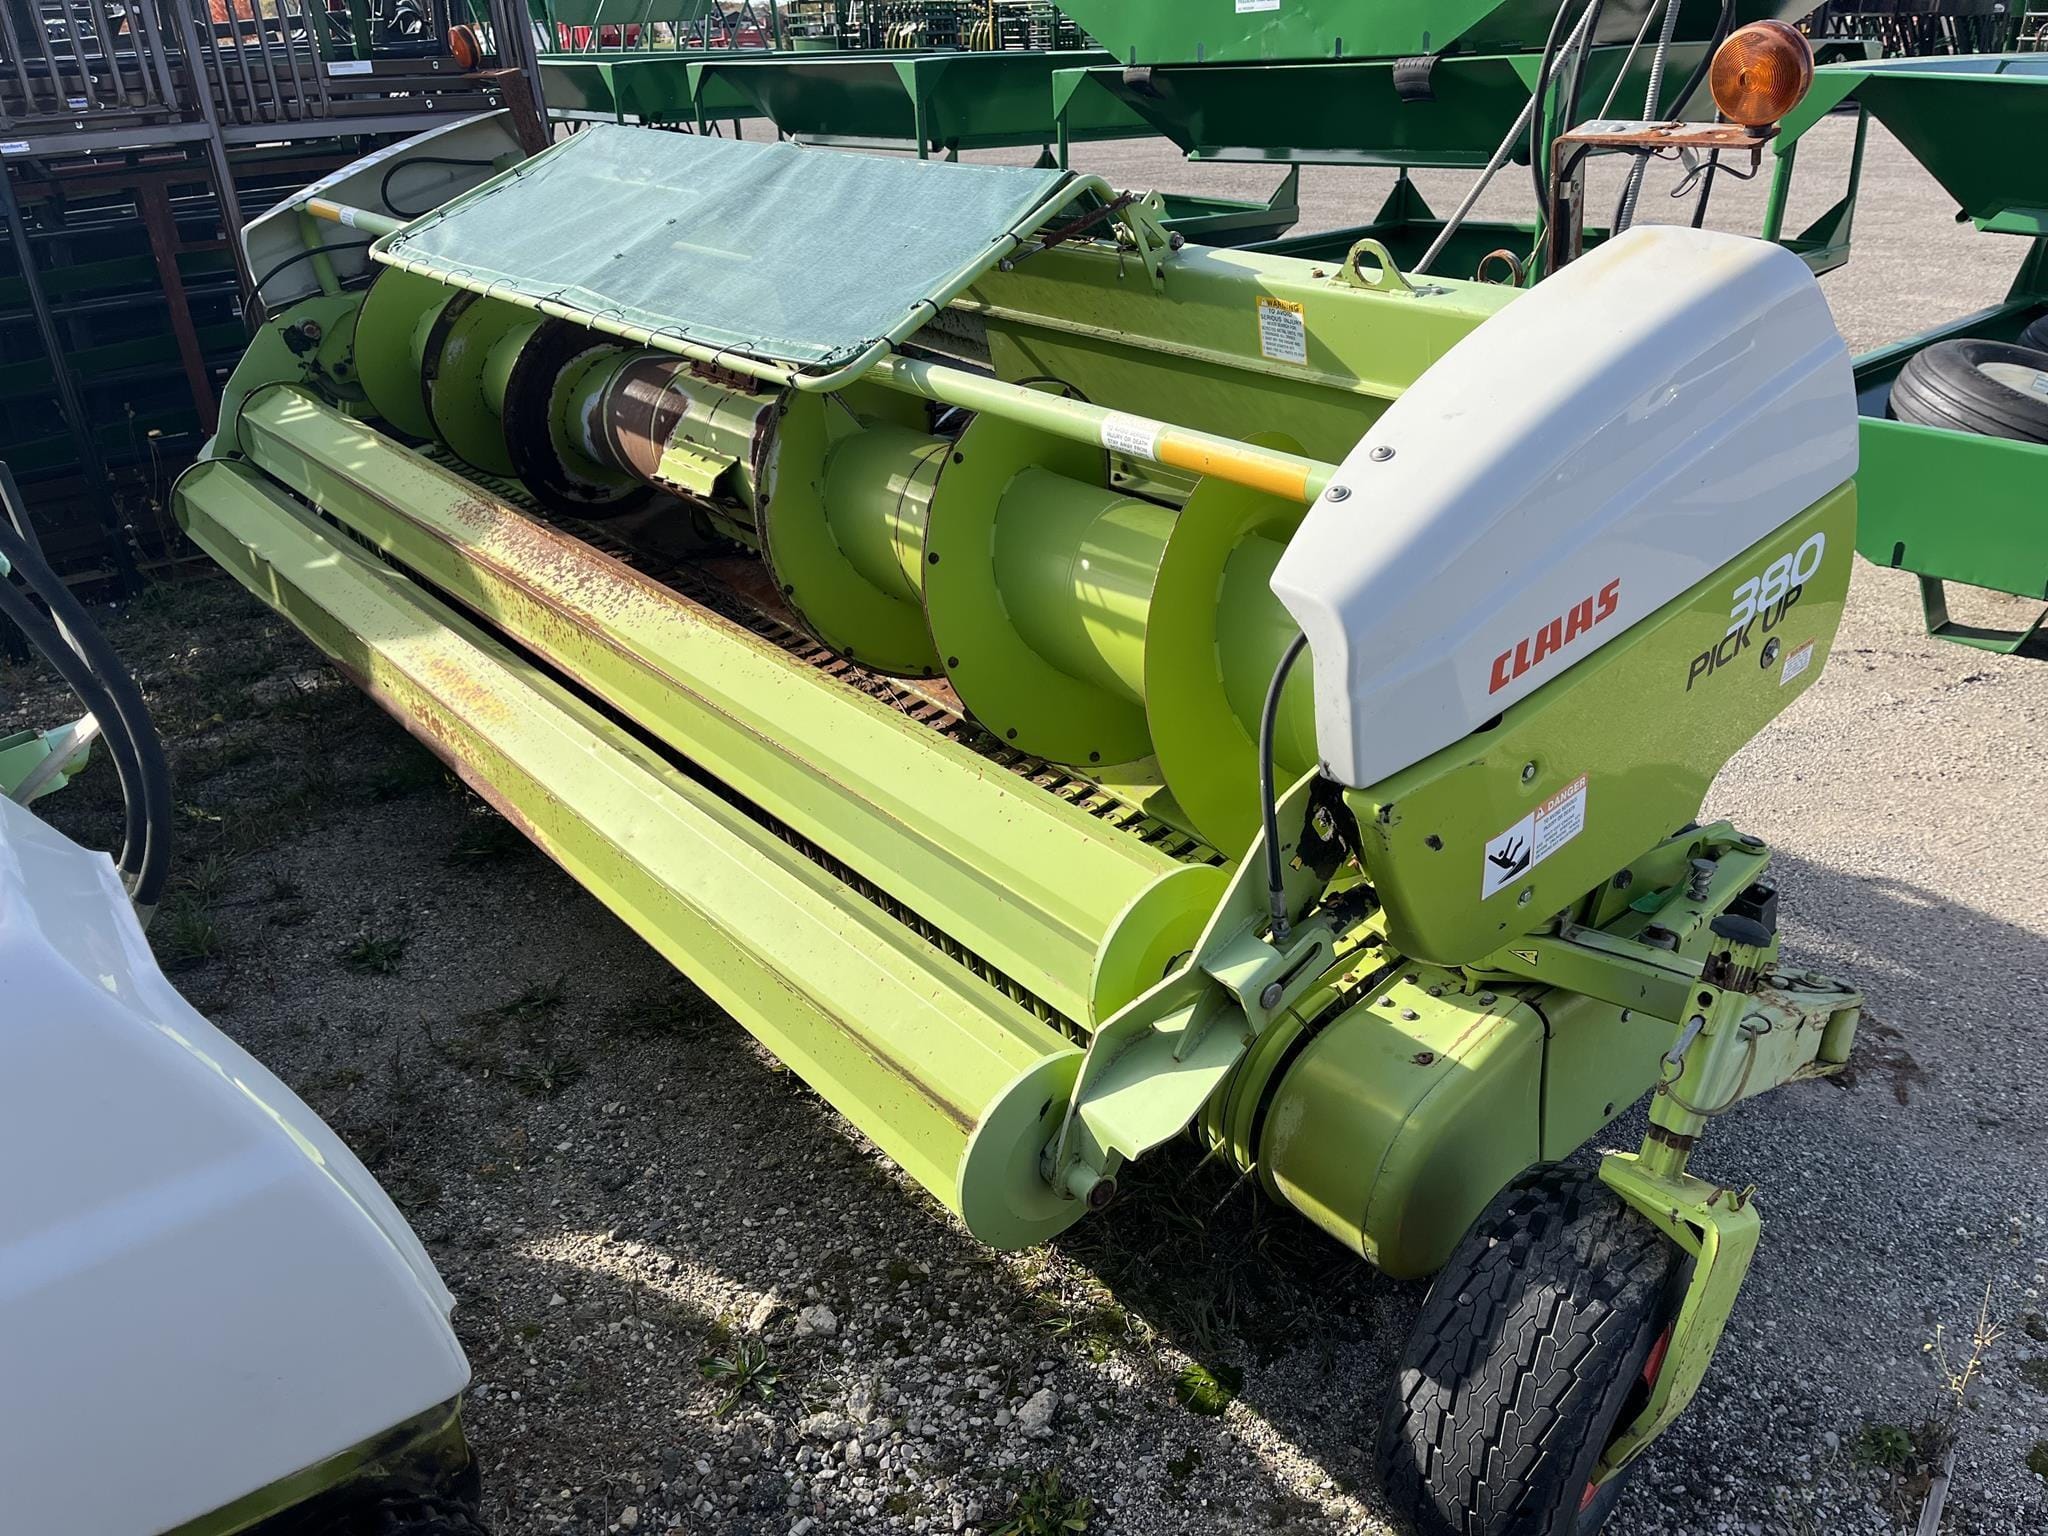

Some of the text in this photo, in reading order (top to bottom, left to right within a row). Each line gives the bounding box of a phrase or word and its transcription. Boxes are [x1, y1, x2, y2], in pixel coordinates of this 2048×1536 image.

[1260, 314, 1282, 323] SERIOUS
[1267, 299, 1299, 312] WARNING
[1276, 309, 1293, 317] AVOID
[1727, 532, 1826, 637] 380
[1489, 576, 1621, 695] CLAAS
[1686, 615, 1757, 692] PICK
[1761, 583, 1803, 634] UP
[1547, 776, 1586, 811] DANGER
